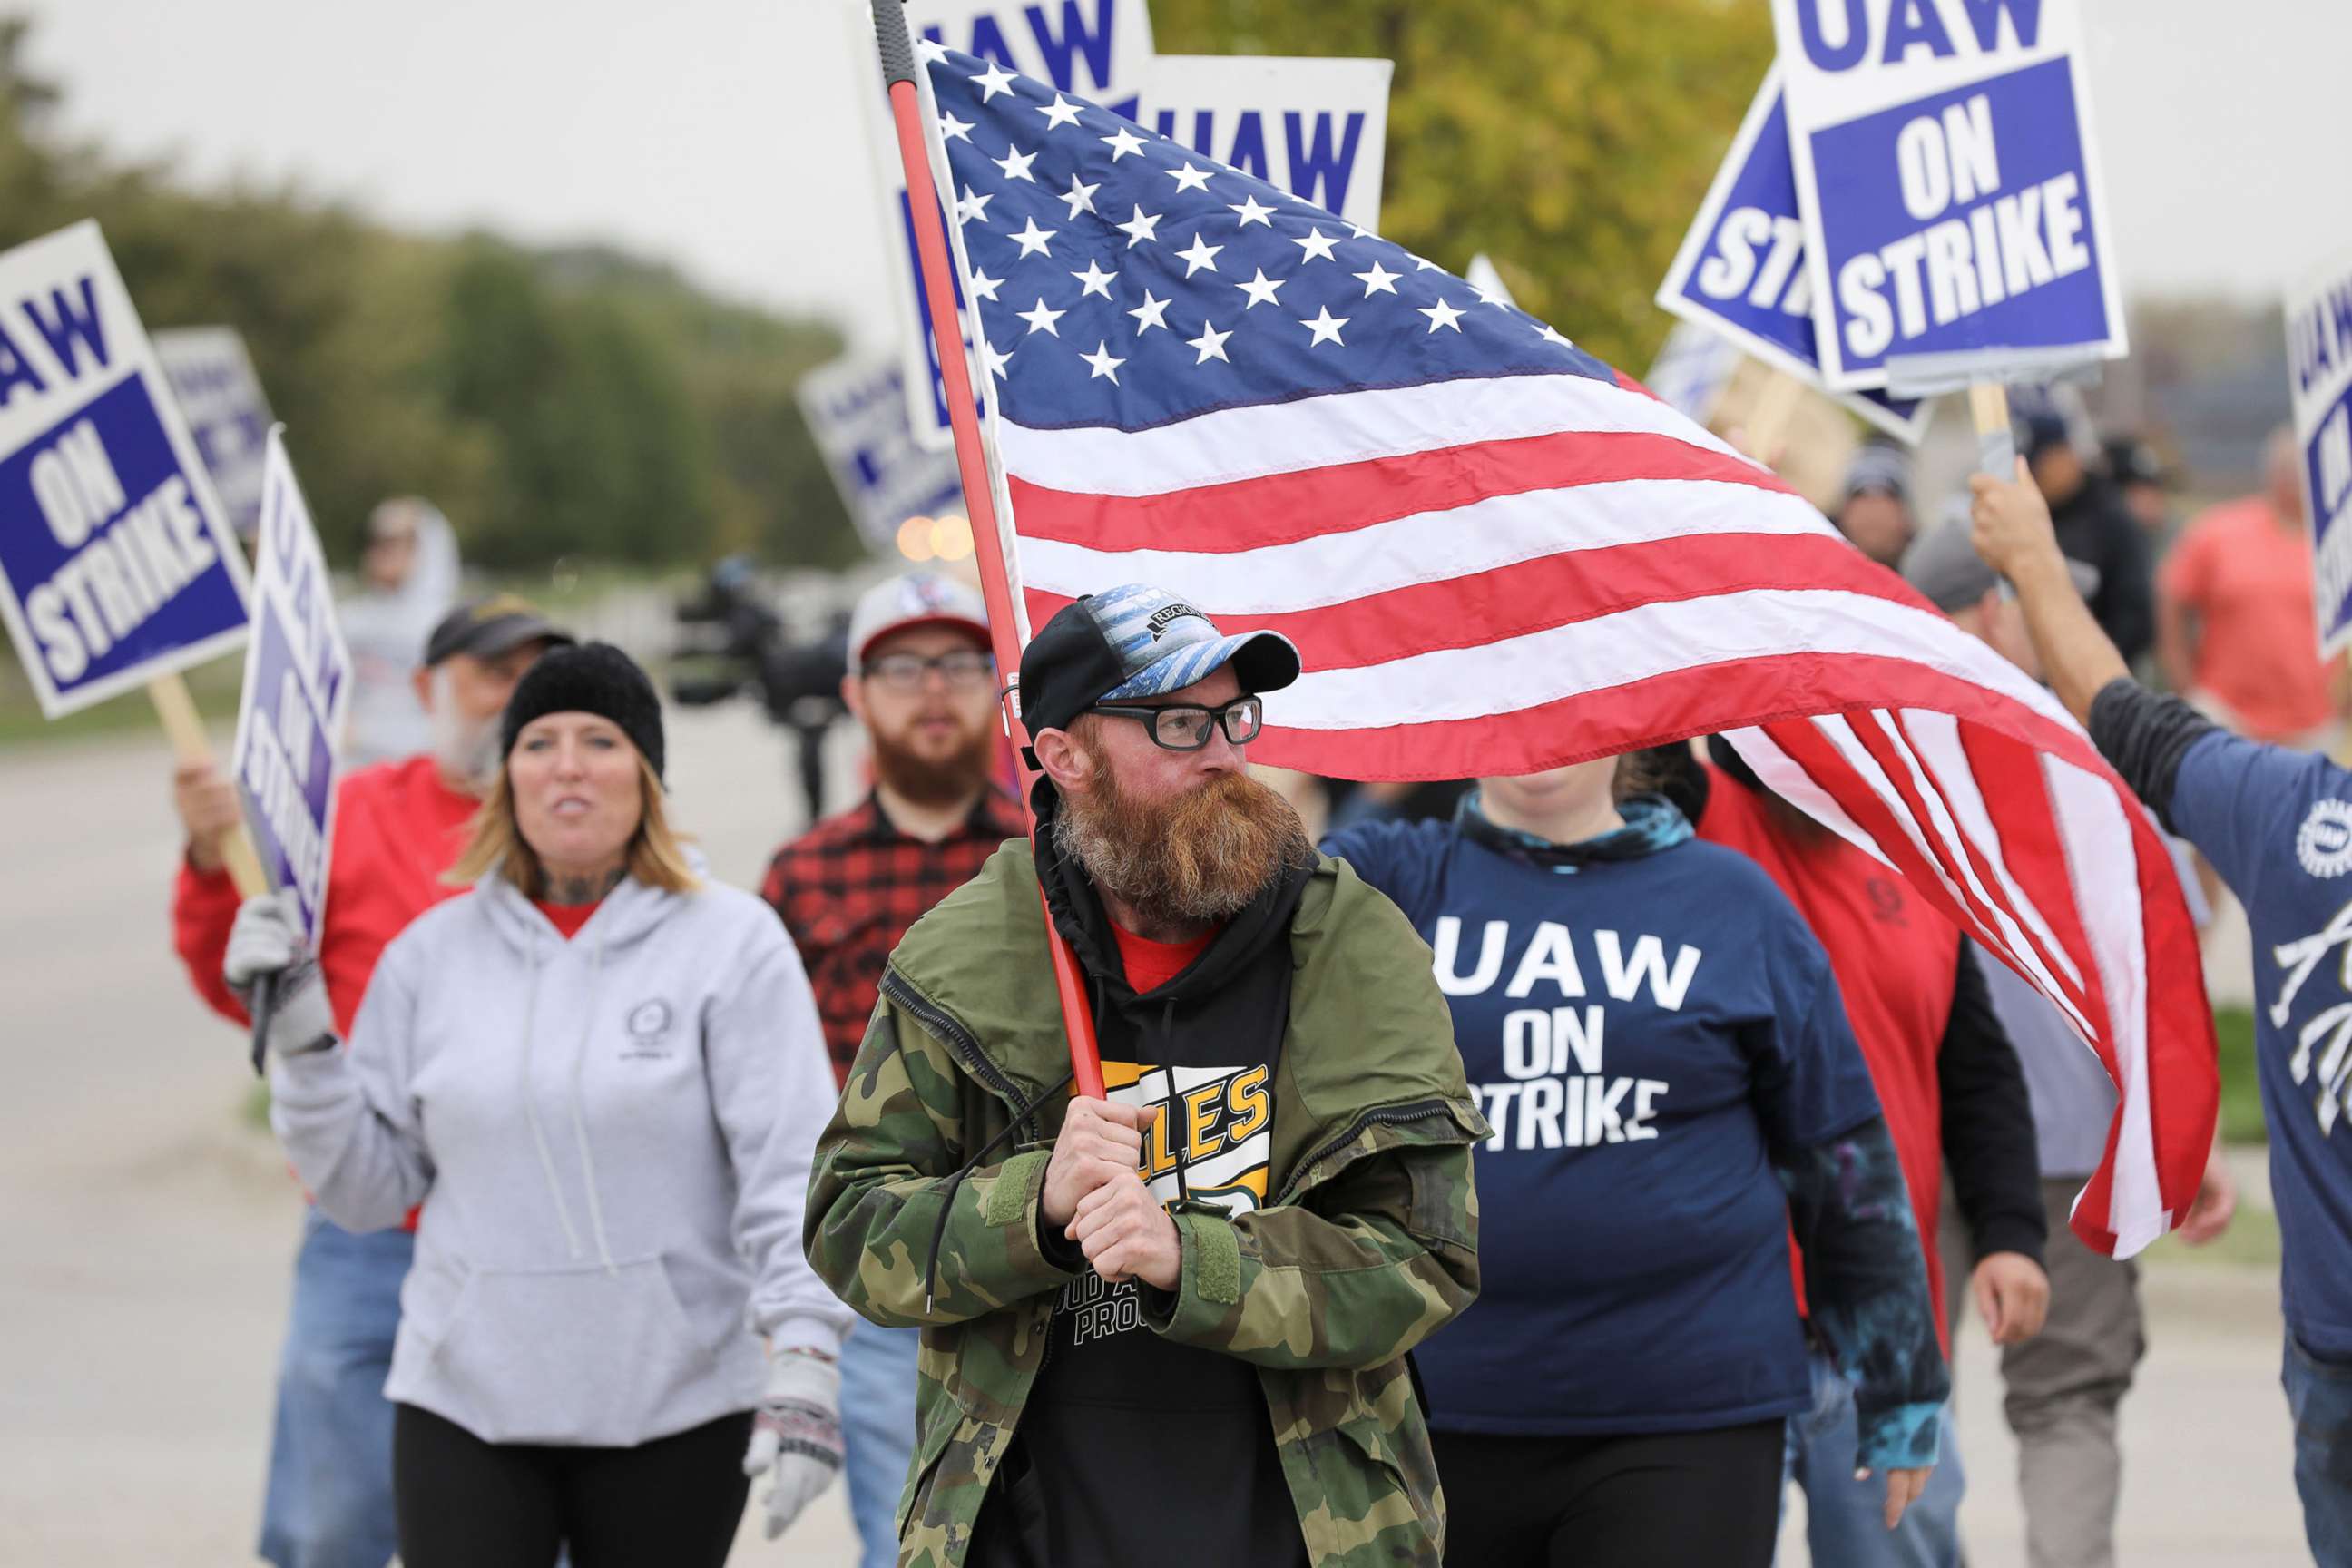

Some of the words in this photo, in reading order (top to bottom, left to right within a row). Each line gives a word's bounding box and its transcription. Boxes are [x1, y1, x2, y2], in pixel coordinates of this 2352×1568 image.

[923, 0, 1113, 93] AW
[1896, 92, 2001, 220] ON
[1838, 171, 2091, 359] STRIKE
[29, 416, 127, 550] ON
[25, 473, 219, 682] STRIKE
[1432, 916, 1703, 1012] UAW
[1502, 1004, 1605, 1081] ON
[1138, 1063, 1270, 1182] LES
[1466, 1074, 1670, 1152] TRIKE
